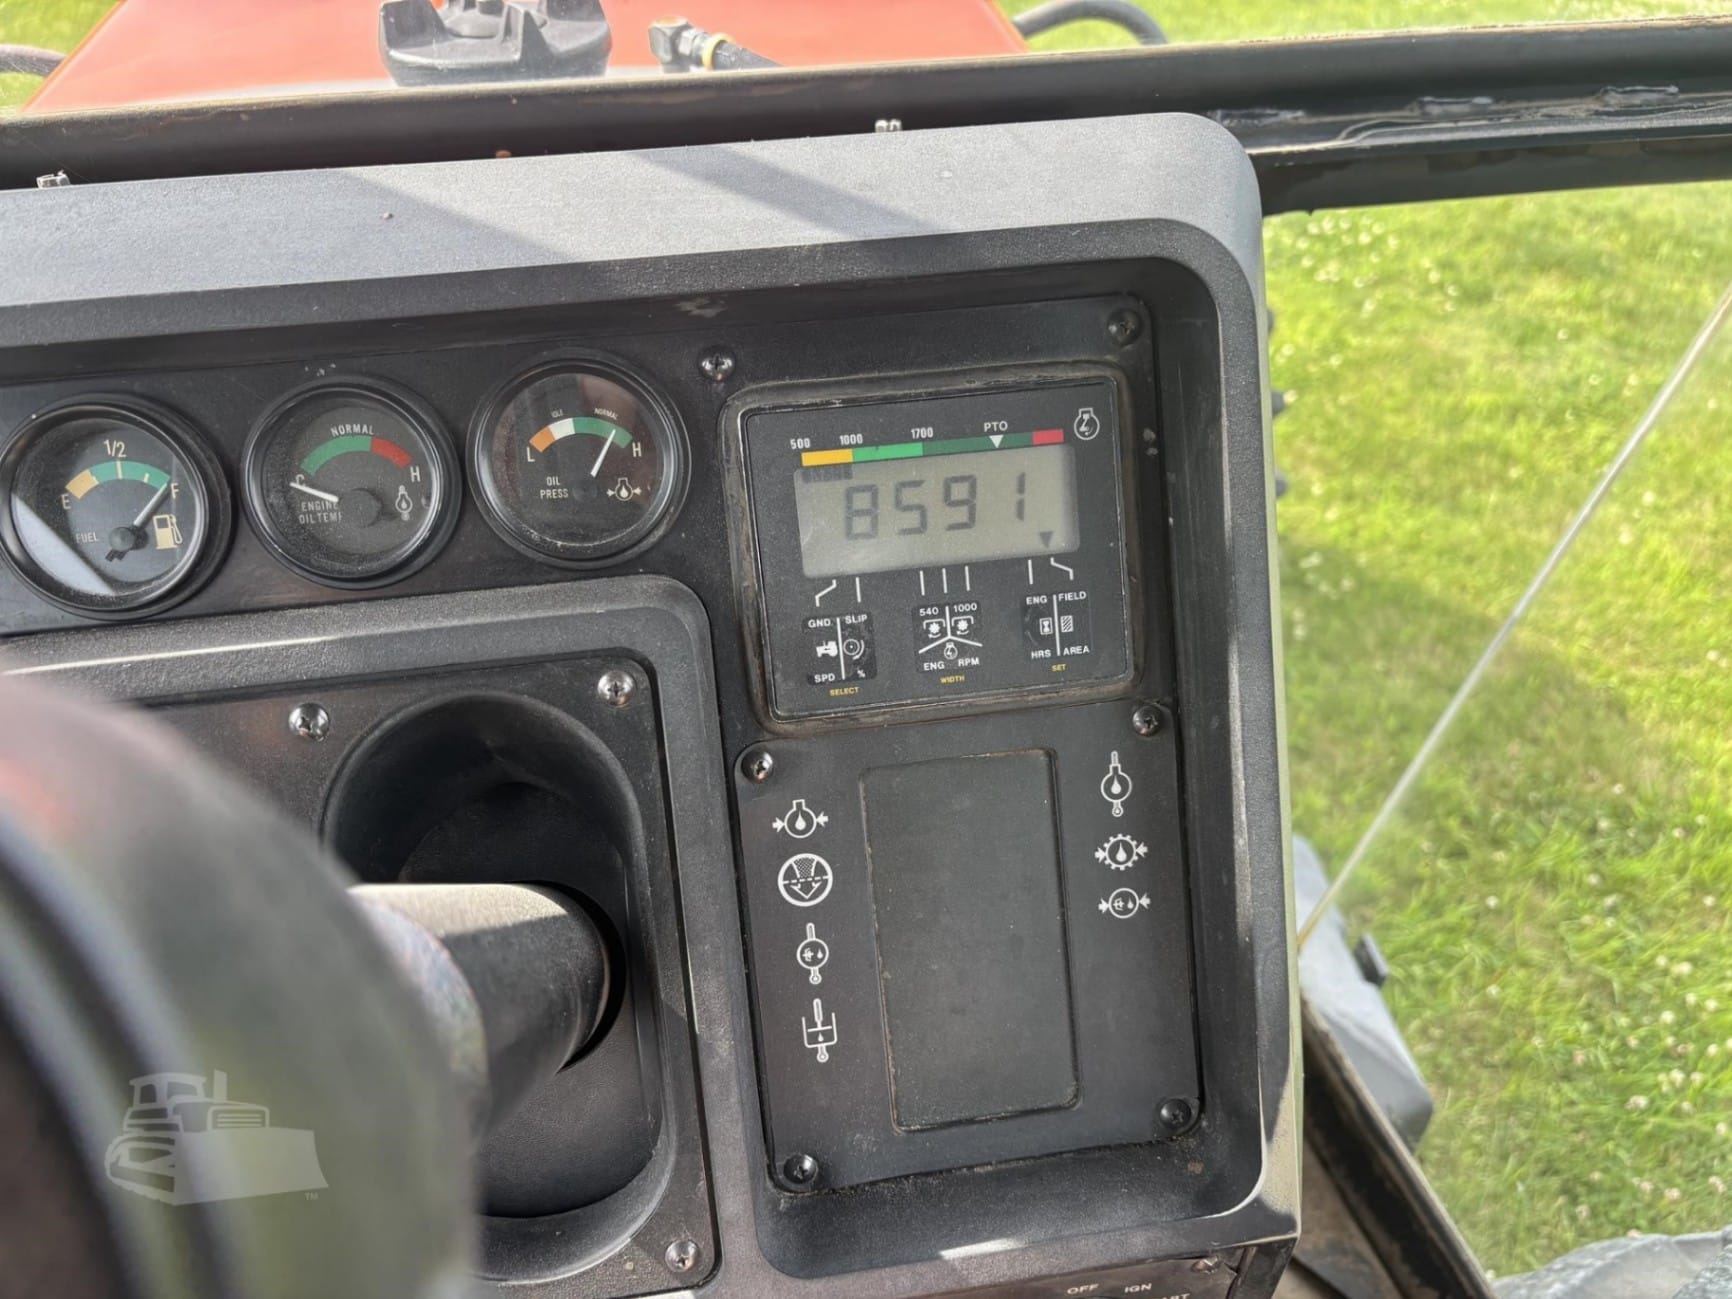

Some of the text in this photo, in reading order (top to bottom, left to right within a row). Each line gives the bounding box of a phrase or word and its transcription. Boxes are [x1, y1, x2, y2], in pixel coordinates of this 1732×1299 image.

[330, 424, 374, 437] NORMAL
[911, 427, 934, 439] 1700
[983, 421, 1008, 433] PTO
[790, 438, 811, 450] 500
[839, 433, 863, 445] 1000
[104, 439, 127, 458] 1/2
[526, 447, 535, 462] L
[632, 442, 642, 458] H
[410, 466, 421, 482] H
[546, 476, 560, 486] OIL
[171, 483, 179, 499] F
[540, 489, 569, 499] PRESS
[61, 494, 71, 509] E
[301, 501, 338, 511] ENGINE
[845, 471, 1026, 541] 8591
[298, 514, 316, 524] OIL
[75, 532, 99, 543] FUEL
[1026, 591, 1087, 605] ENG FIELD
[919, 602, 978, 617] 540 1000
[808, 614, 868, 629] GND SLIP
[1031, 645, 1090, 660] HRS AREA
[923, 657, 980, 671] ENG RPM
[1051, 663, 1067, 672] SET
[814, 672, 835, 683] SPD
[940, 674, 965, 684] WIDTH
[829, 686, 860, 696] SELECT
[1066, 1282, 1152, 1294] OFF IGN
